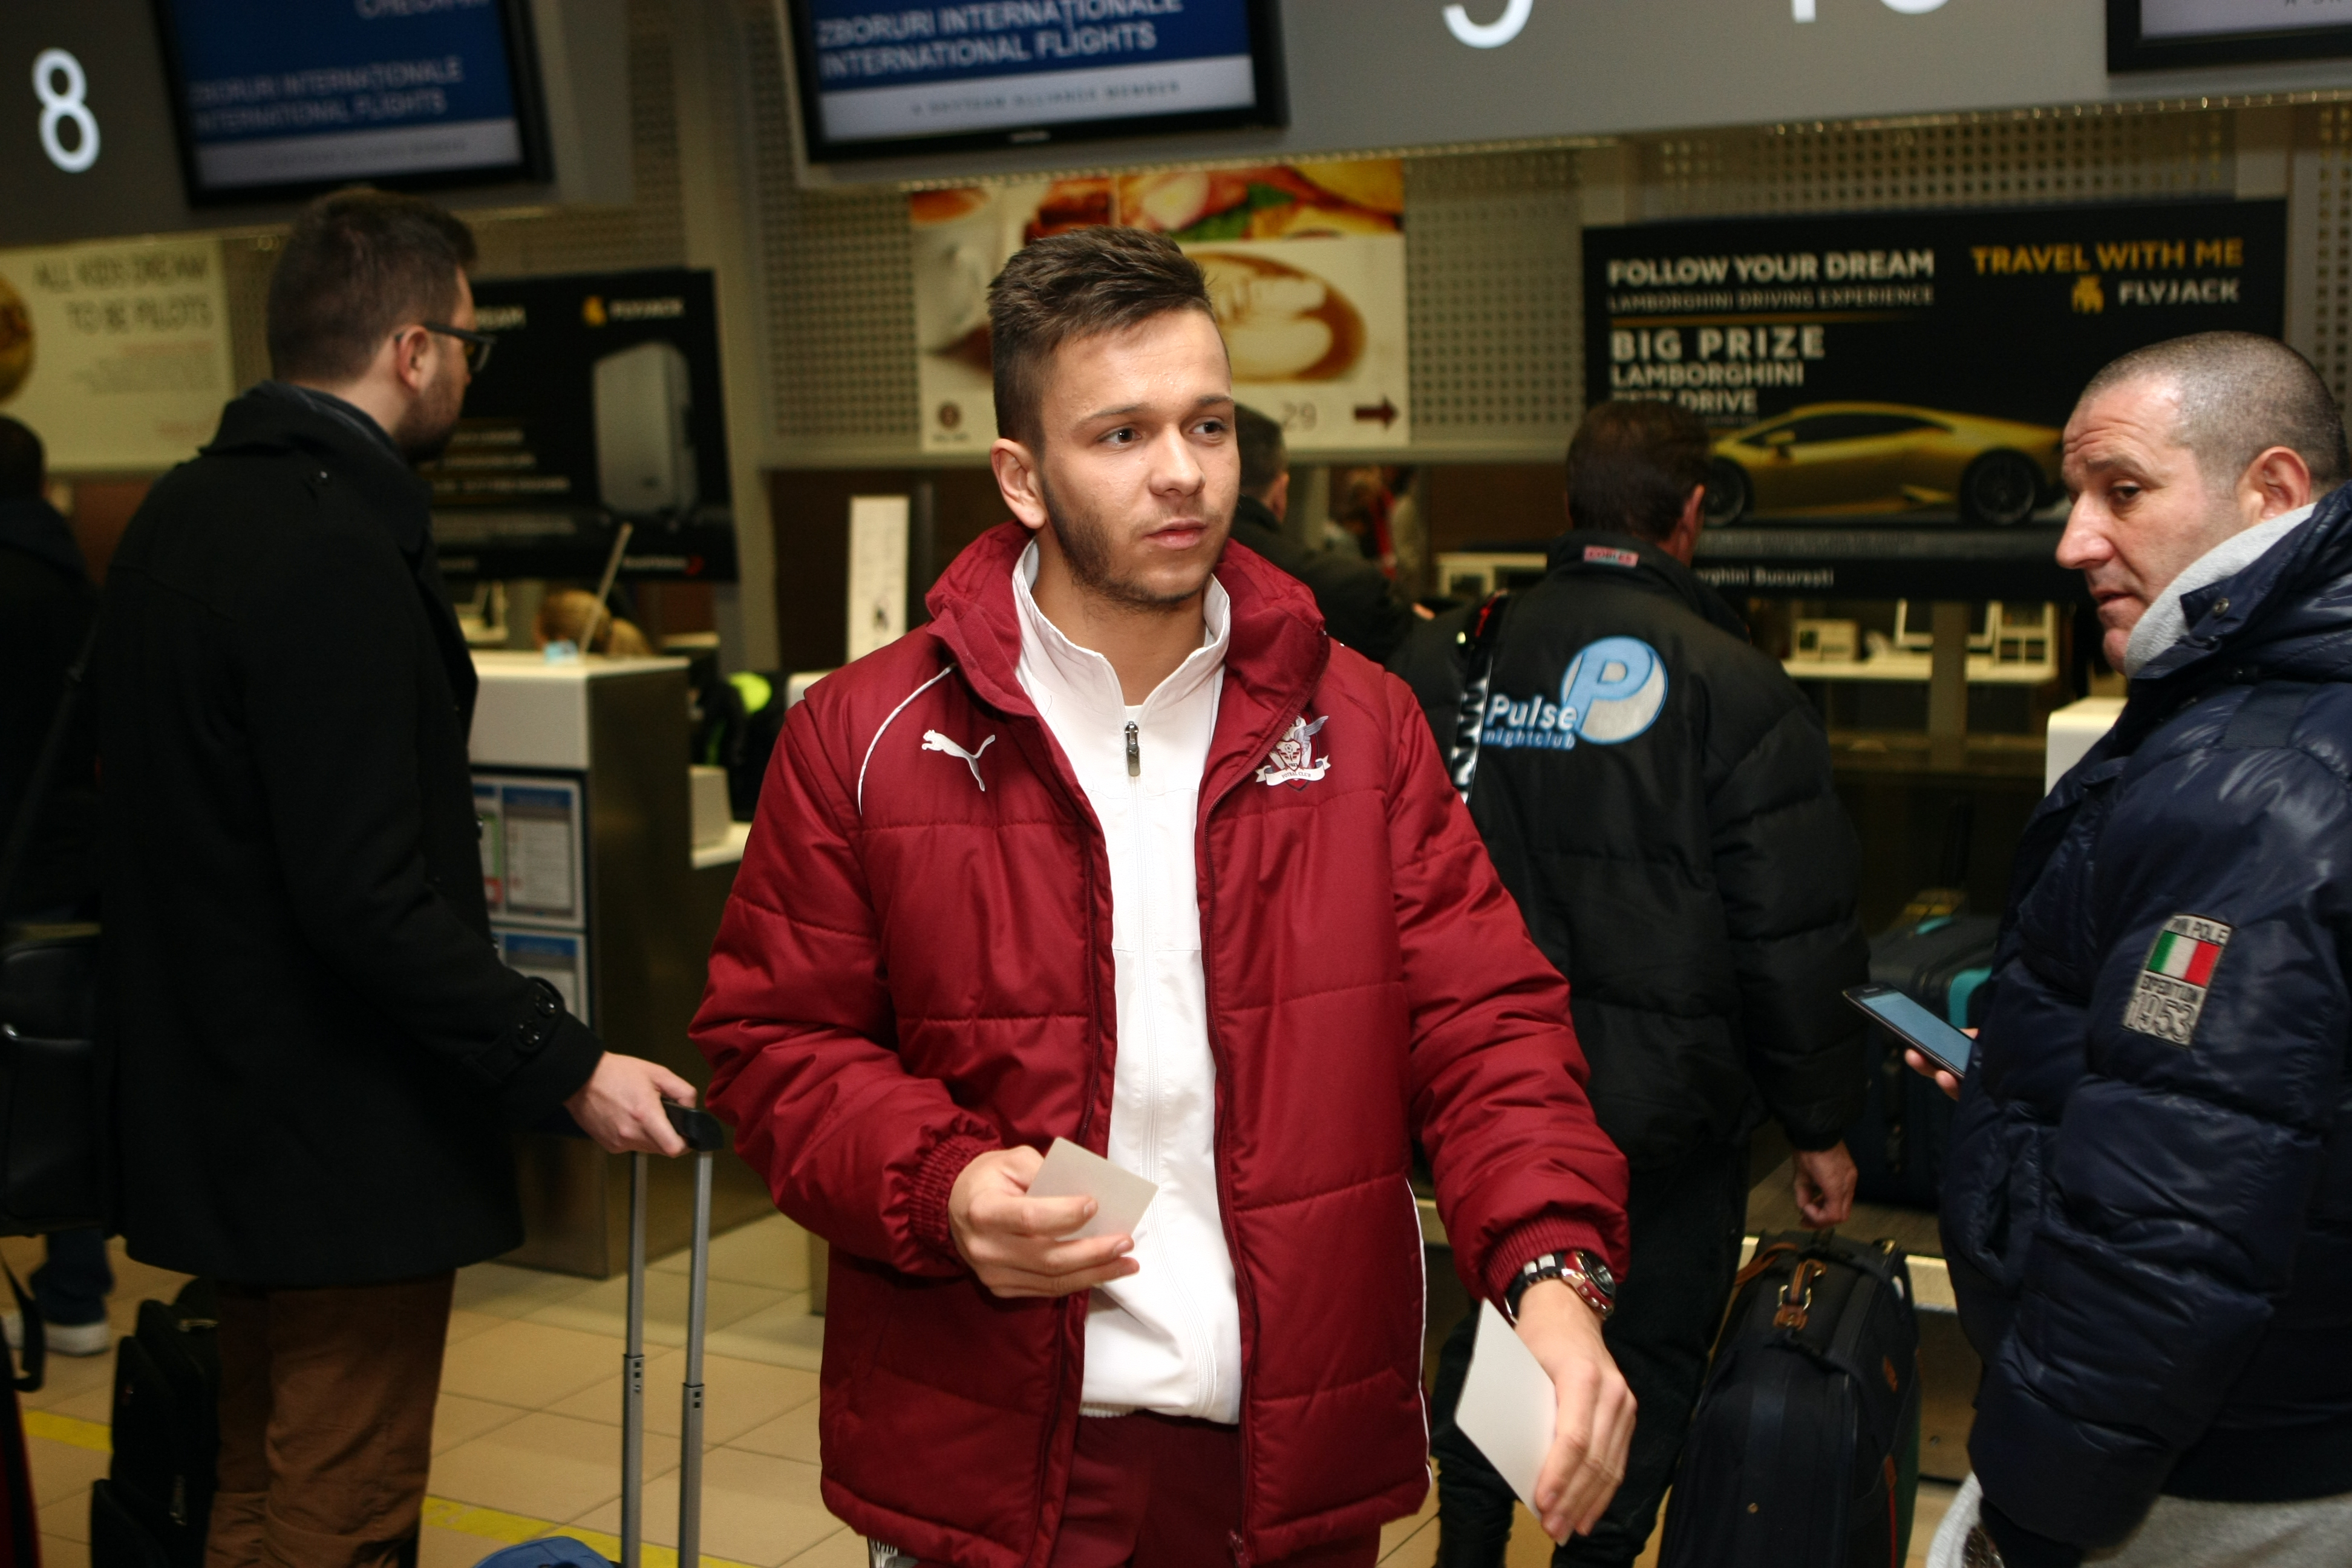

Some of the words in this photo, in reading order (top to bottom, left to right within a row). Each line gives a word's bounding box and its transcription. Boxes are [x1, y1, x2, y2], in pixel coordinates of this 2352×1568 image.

[817, 10, 936, 50] ZBORURI
[820, 34, 1031, 79] INTERNATIONAL
[1034, 21, 1157, 59] FLIGHTS
[32, 47, 100, 173] 8
[1607, 255, 1728, 286] FOLLOW
[1732, 251, 1818, 283] YOUR
[1824, 247, 1934, 281] DREAM
[1970, 244, 2091, 275] TRAVEL
[2095, 241, 2186, 271] WITH
[2194, 237, 2244, 267] ME
[2118, 278, 2239, 305] FLYJACK
[1610, 328, 1682, 362] BIG
[1697, 325, 1825, 359] PRIZE
[1610, 361, 1804, 389] LAMBORGHINI
[1678, 390, 1757, 413] DRIVE
[1566, 635, 1656, 738] P
[1484, 693, 1578, 730] Pulse
[1481, 728, 1576, 750] nightclub
